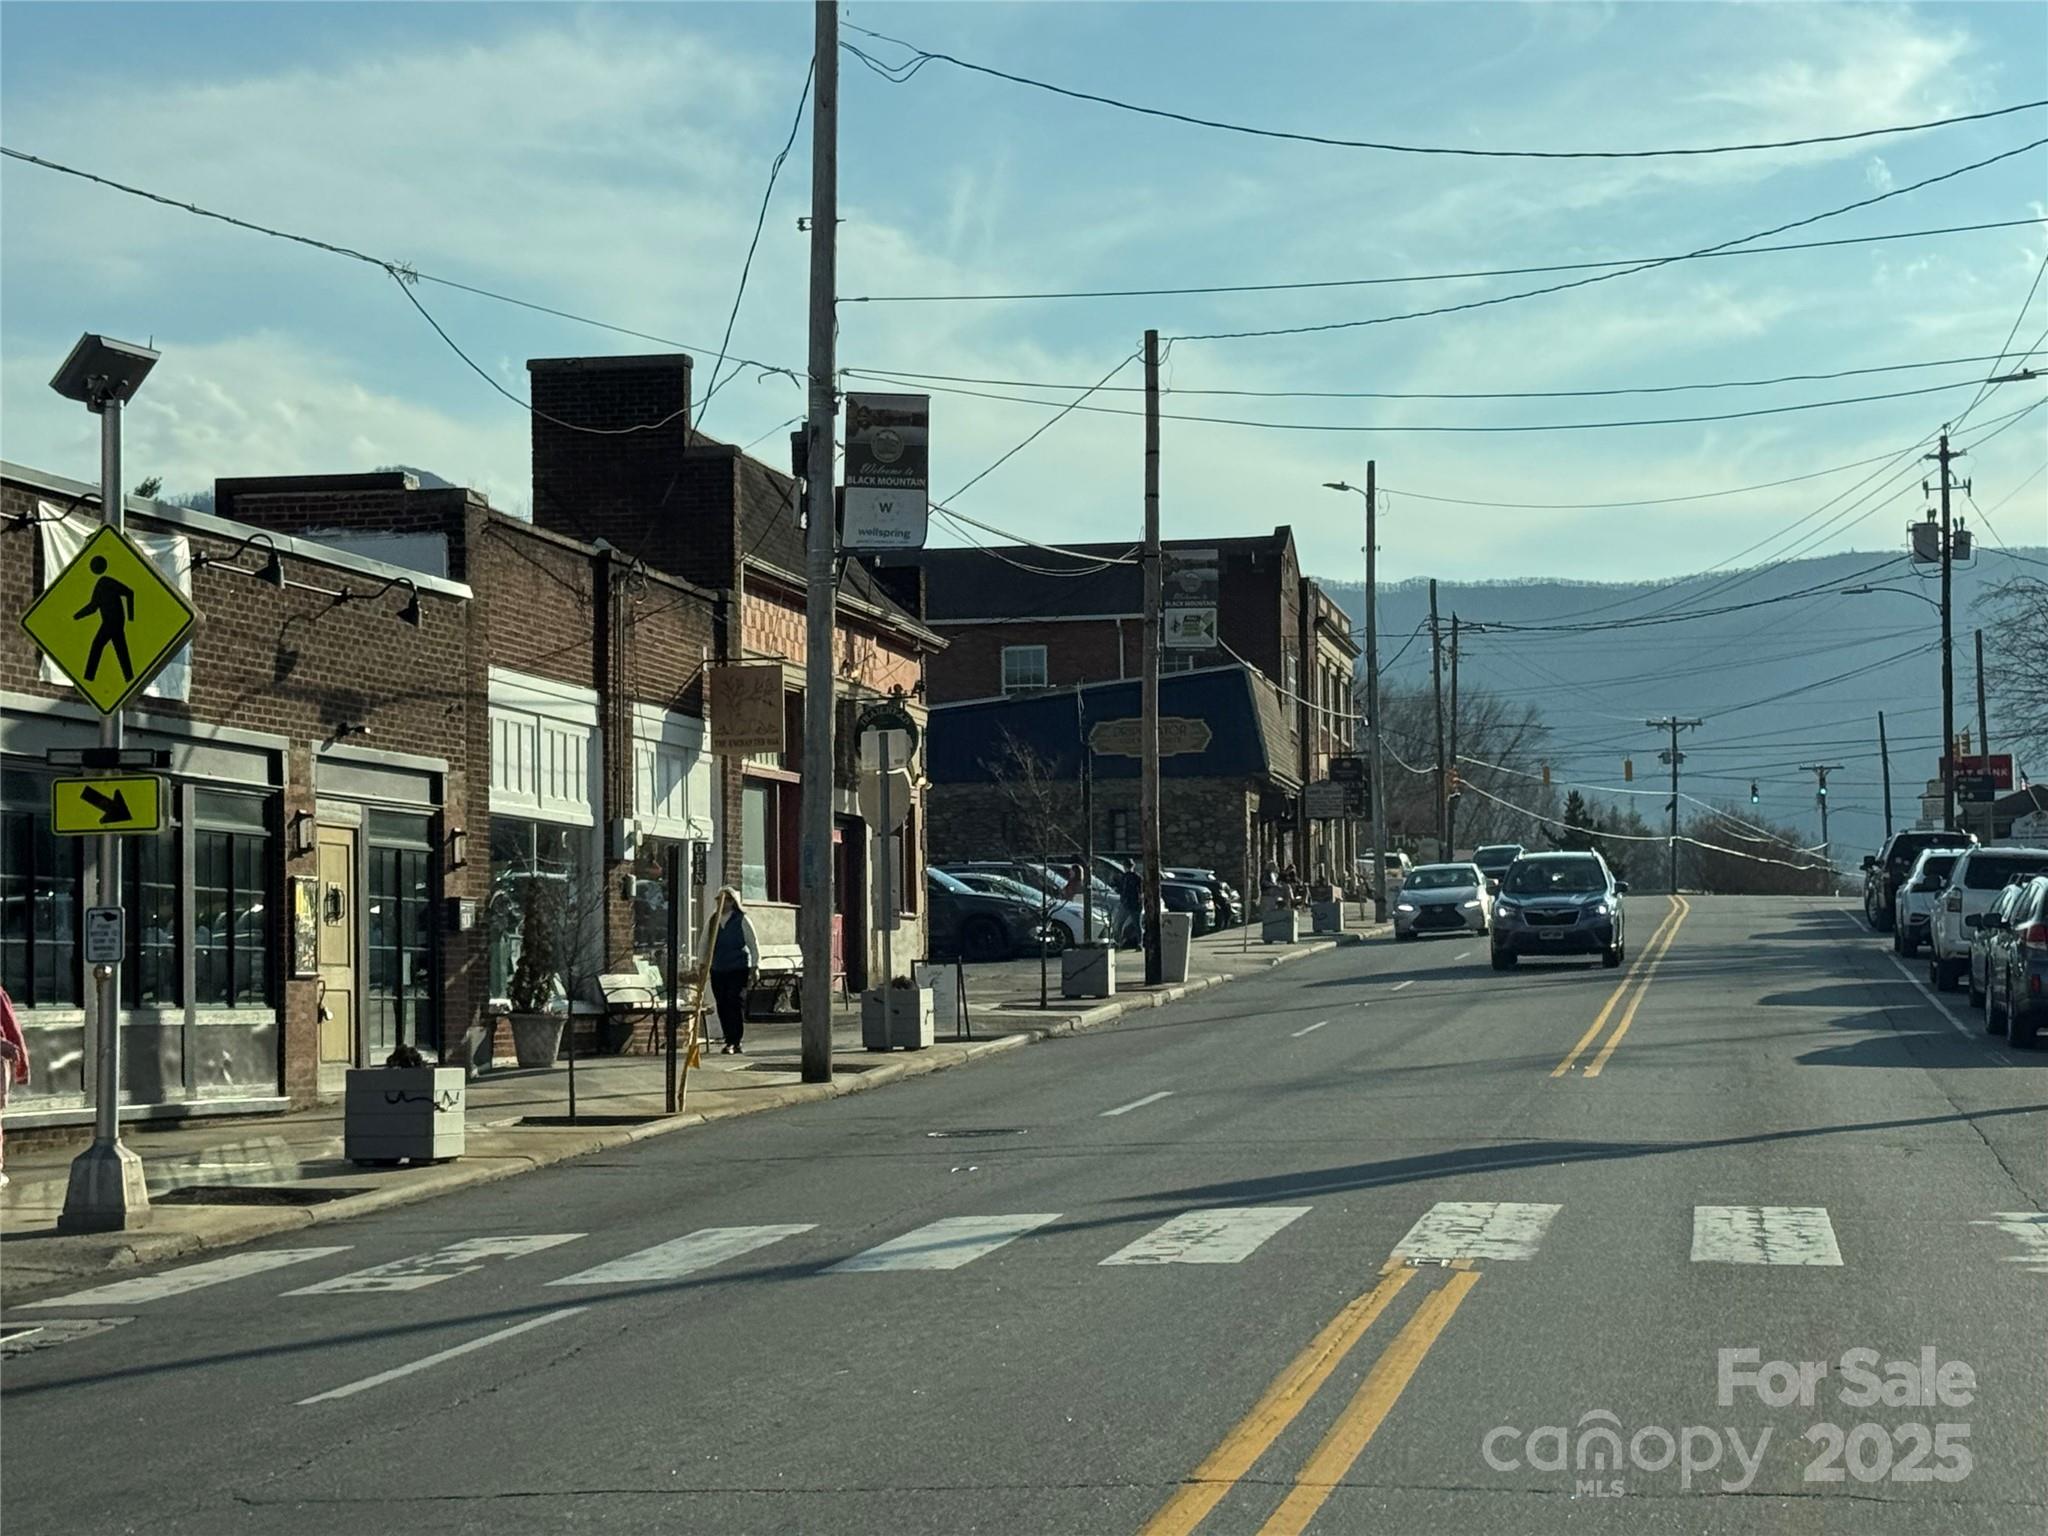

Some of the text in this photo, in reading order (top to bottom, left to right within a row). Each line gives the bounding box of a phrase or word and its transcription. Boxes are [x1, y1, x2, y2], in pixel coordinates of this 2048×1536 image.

[847, 475, 927, 488] BLACK MOUNTAIN
[879, 502, 894, 513] W
[858, 527, 912, 540] wellspring
[694, 844, 705, 883] OPEN
